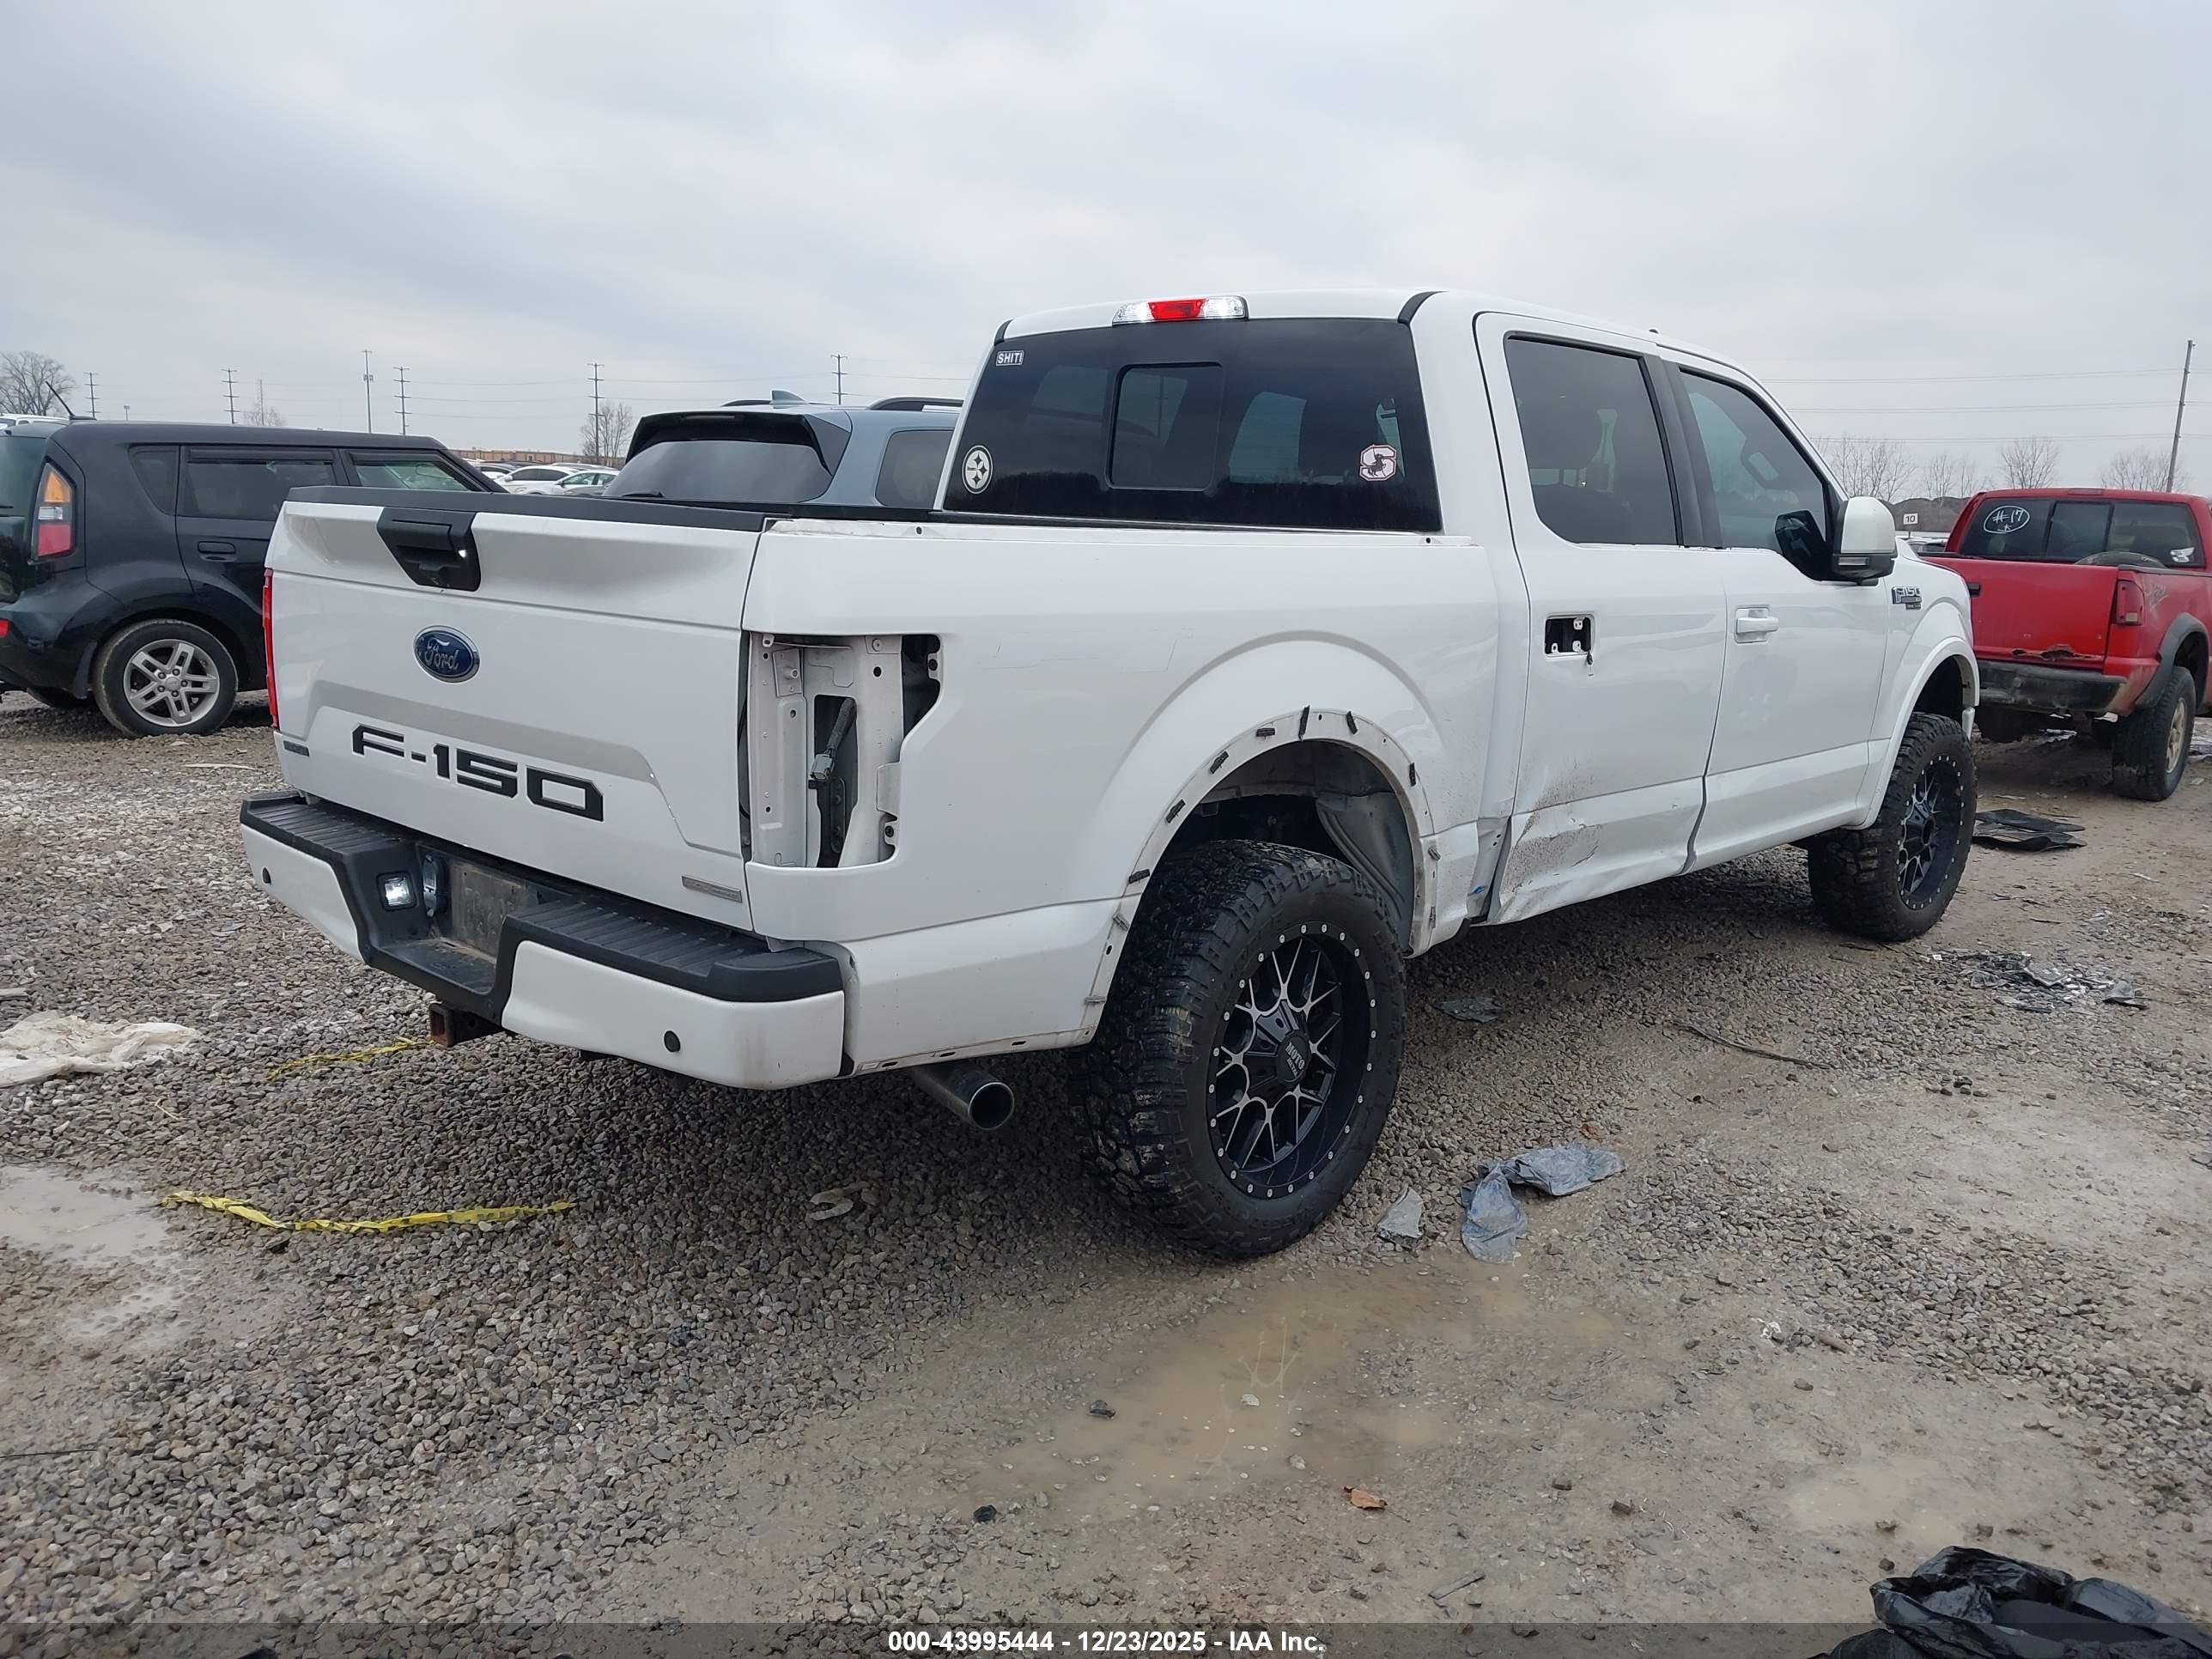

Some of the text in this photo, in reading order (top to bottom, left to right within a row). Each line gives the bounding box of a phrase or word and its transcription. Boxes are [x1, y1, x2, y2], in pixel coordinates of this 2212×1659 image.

[1991, 509, 2024, 524] #17
[423, 636, 460, 671] Ford
[352, 723, 604, 822] F-150
[1285, 1042, 1305, 1070] MOTO
